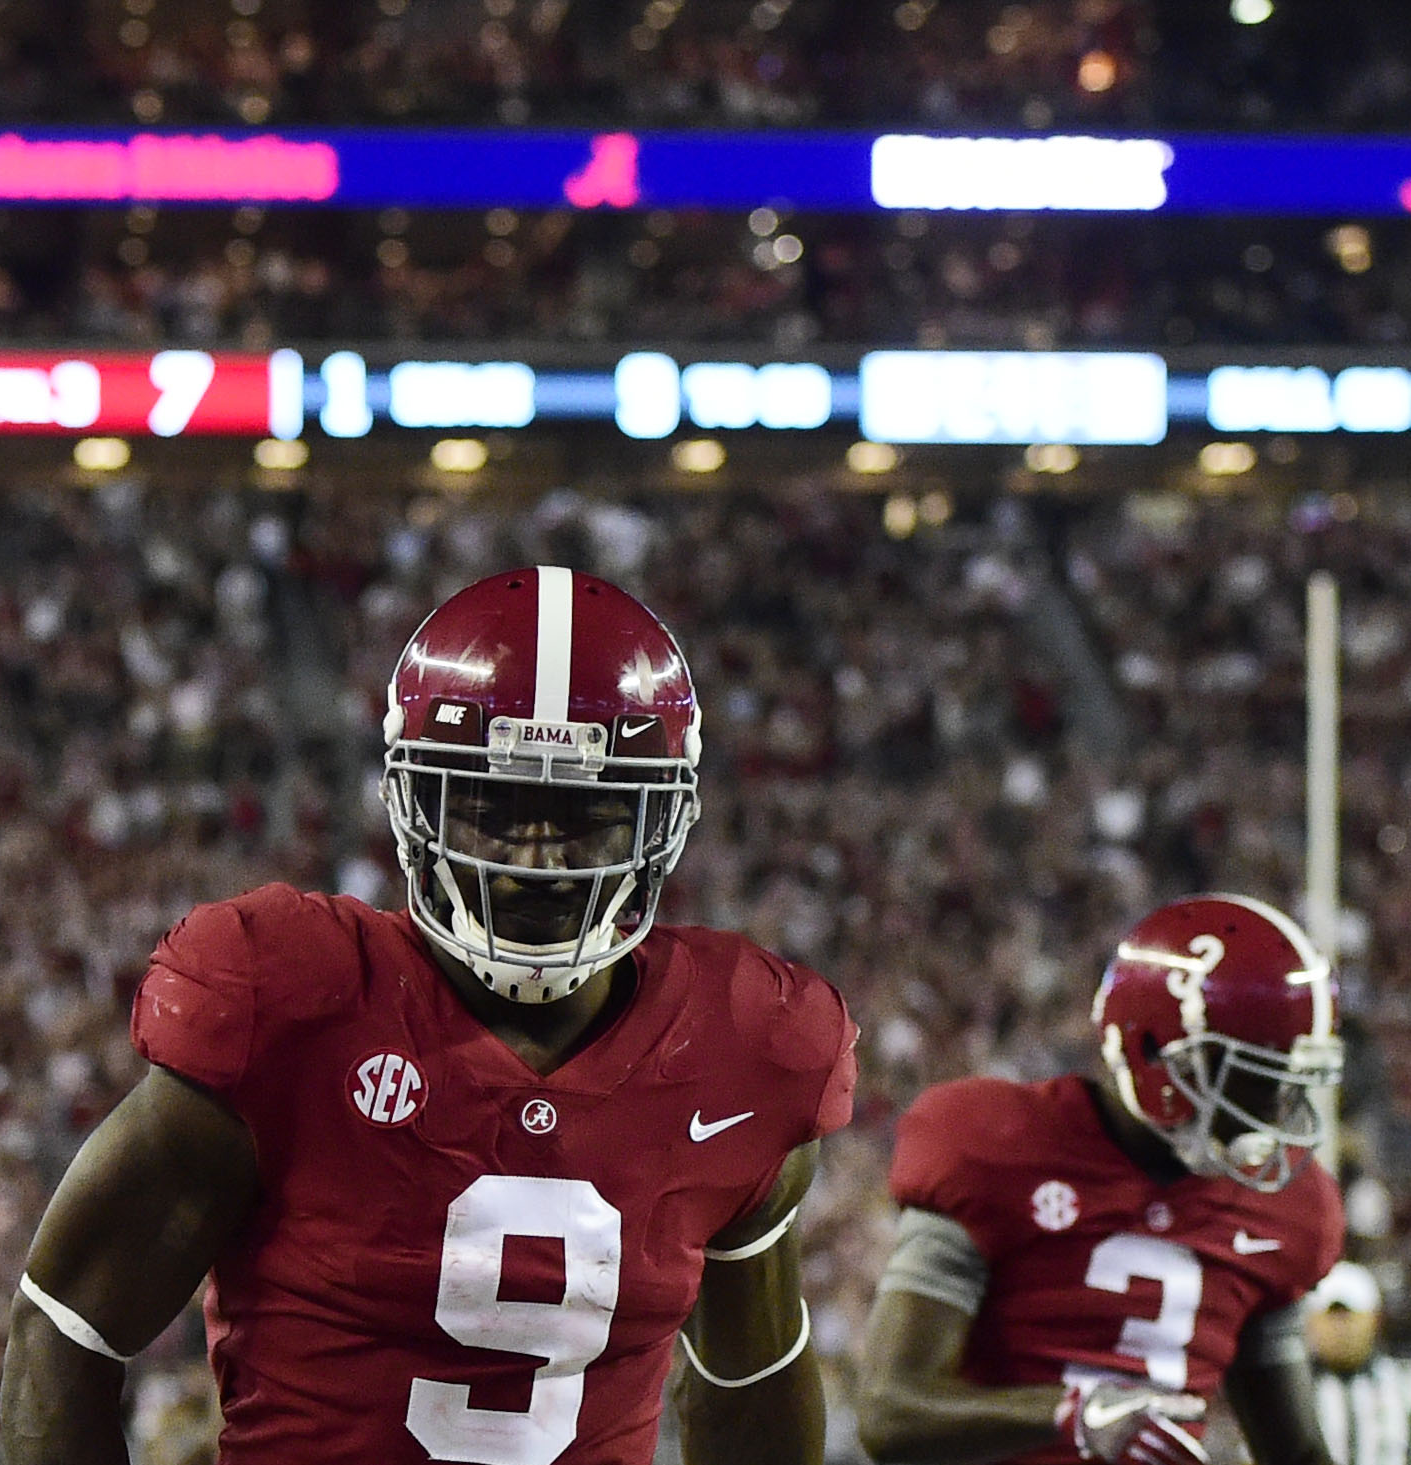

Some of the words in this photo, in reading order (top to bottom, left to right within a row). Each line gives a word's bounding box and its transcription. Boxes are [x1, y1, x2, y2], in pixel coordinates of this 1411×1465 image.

[523, 726, 573, 745] BAMA
[353, 1053, 422, 1124] SEC
[1085, 1233, 1203, 1390] 3
